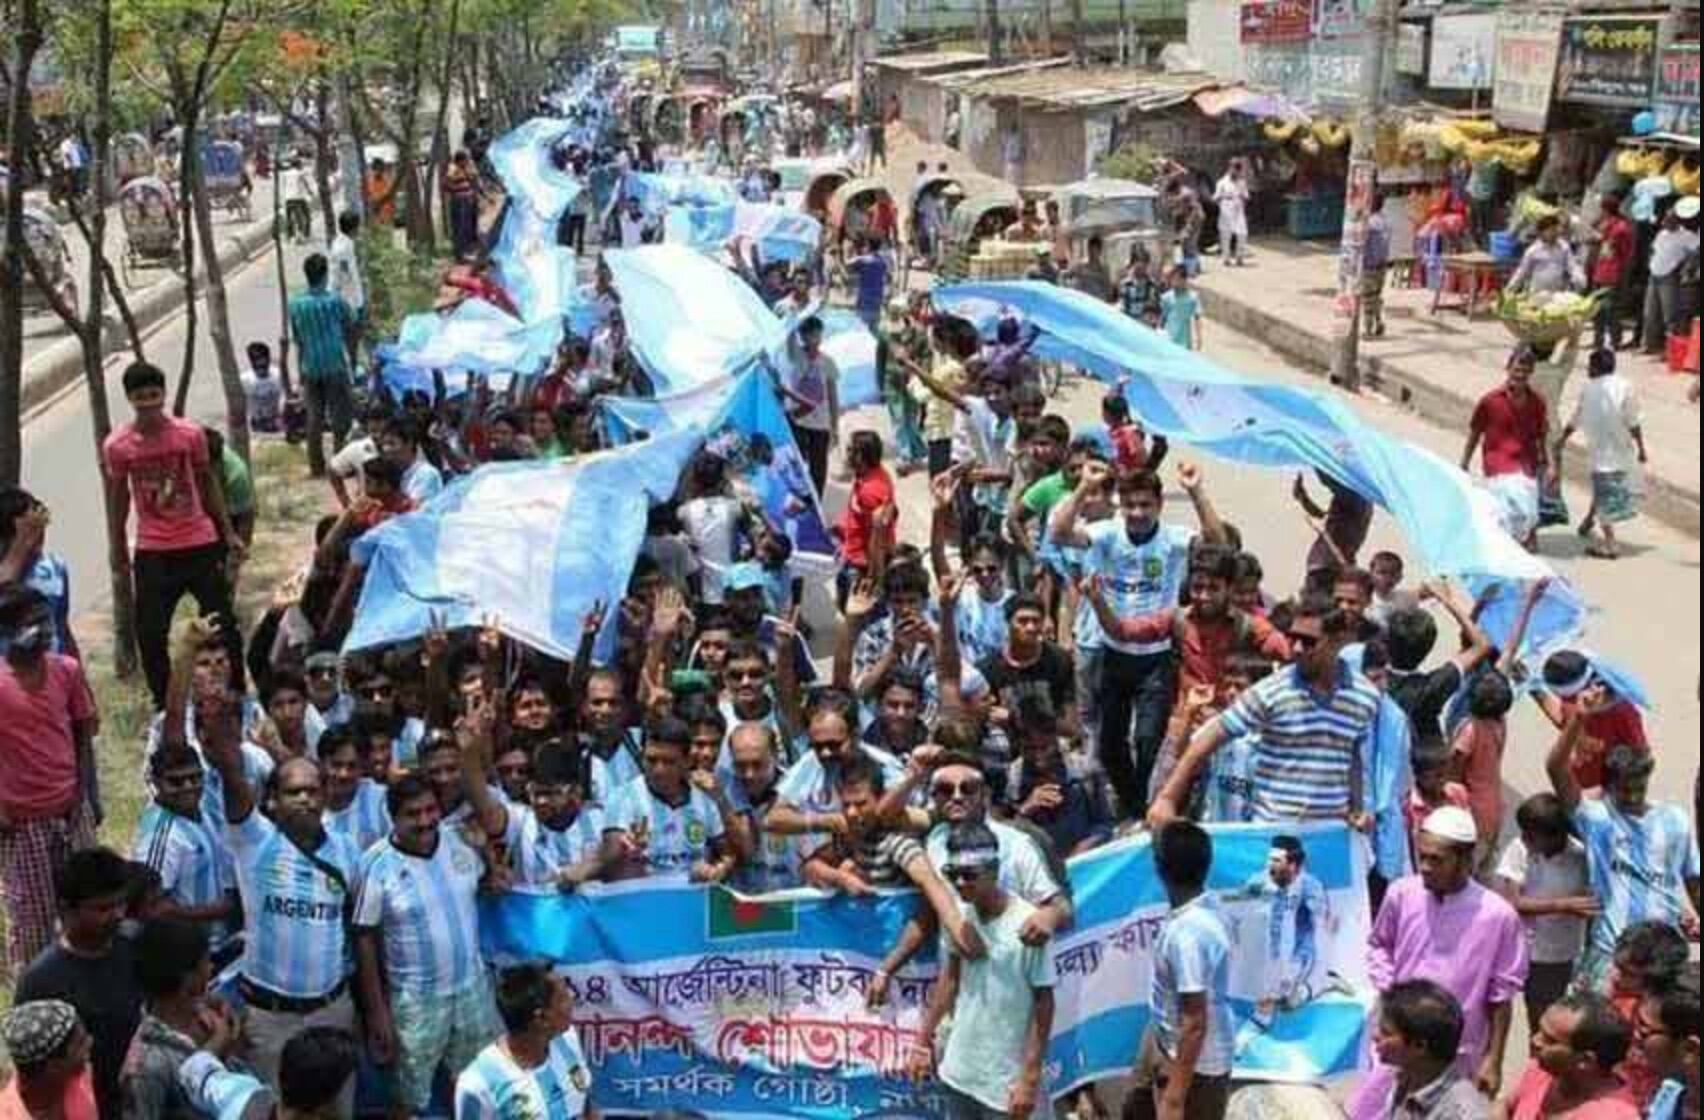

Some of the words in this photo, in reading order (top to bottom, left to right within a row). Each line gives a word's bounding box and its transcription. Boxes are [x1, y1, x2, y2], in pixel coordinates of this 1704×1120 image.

[263, 895, 338, 920] ARGENTIN
[621, 955, 780, 1006] আর্জেন্টিনা
[792, 954, 871, 1005] ফুটব
[611, 1064, 737, 1099] সমর্থক
